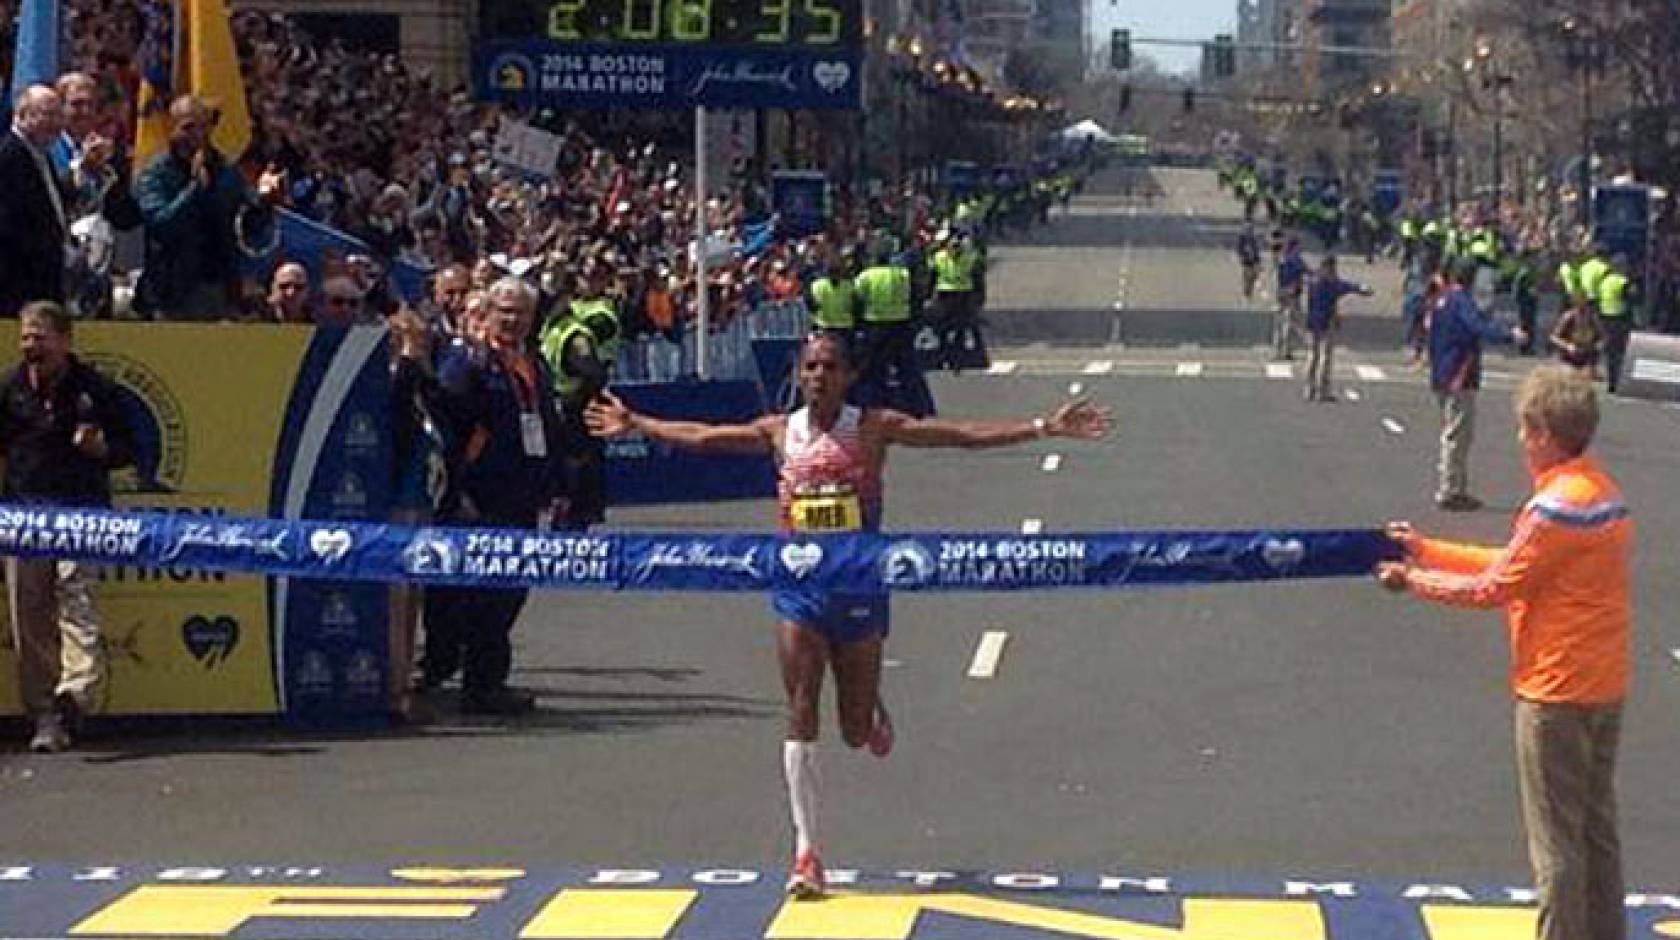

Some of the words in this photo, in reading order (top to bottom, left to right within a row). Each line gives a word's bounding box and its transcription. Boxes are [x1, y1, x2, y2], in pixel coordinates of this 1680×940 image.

[541, 55, 583, 72] 2014
[589, 56, 665, 73] BOSTON
[541, 74, 665, 94] MARATHON
[0, 510, 48, 528] 2014
[54, 513, 141, 533] BOSTON
[0, 527, 140, 555] MARATHON
[467, 533, 513, 552] 2014
[522, 536, 609, 558] BOSTON
[939, 540, 988, 560] 2014
[995, 540, 1086, 560] BOSTON
[464, 555, 608, 580] MARATHON
[938, 560, 1086, 584] MARATHON
